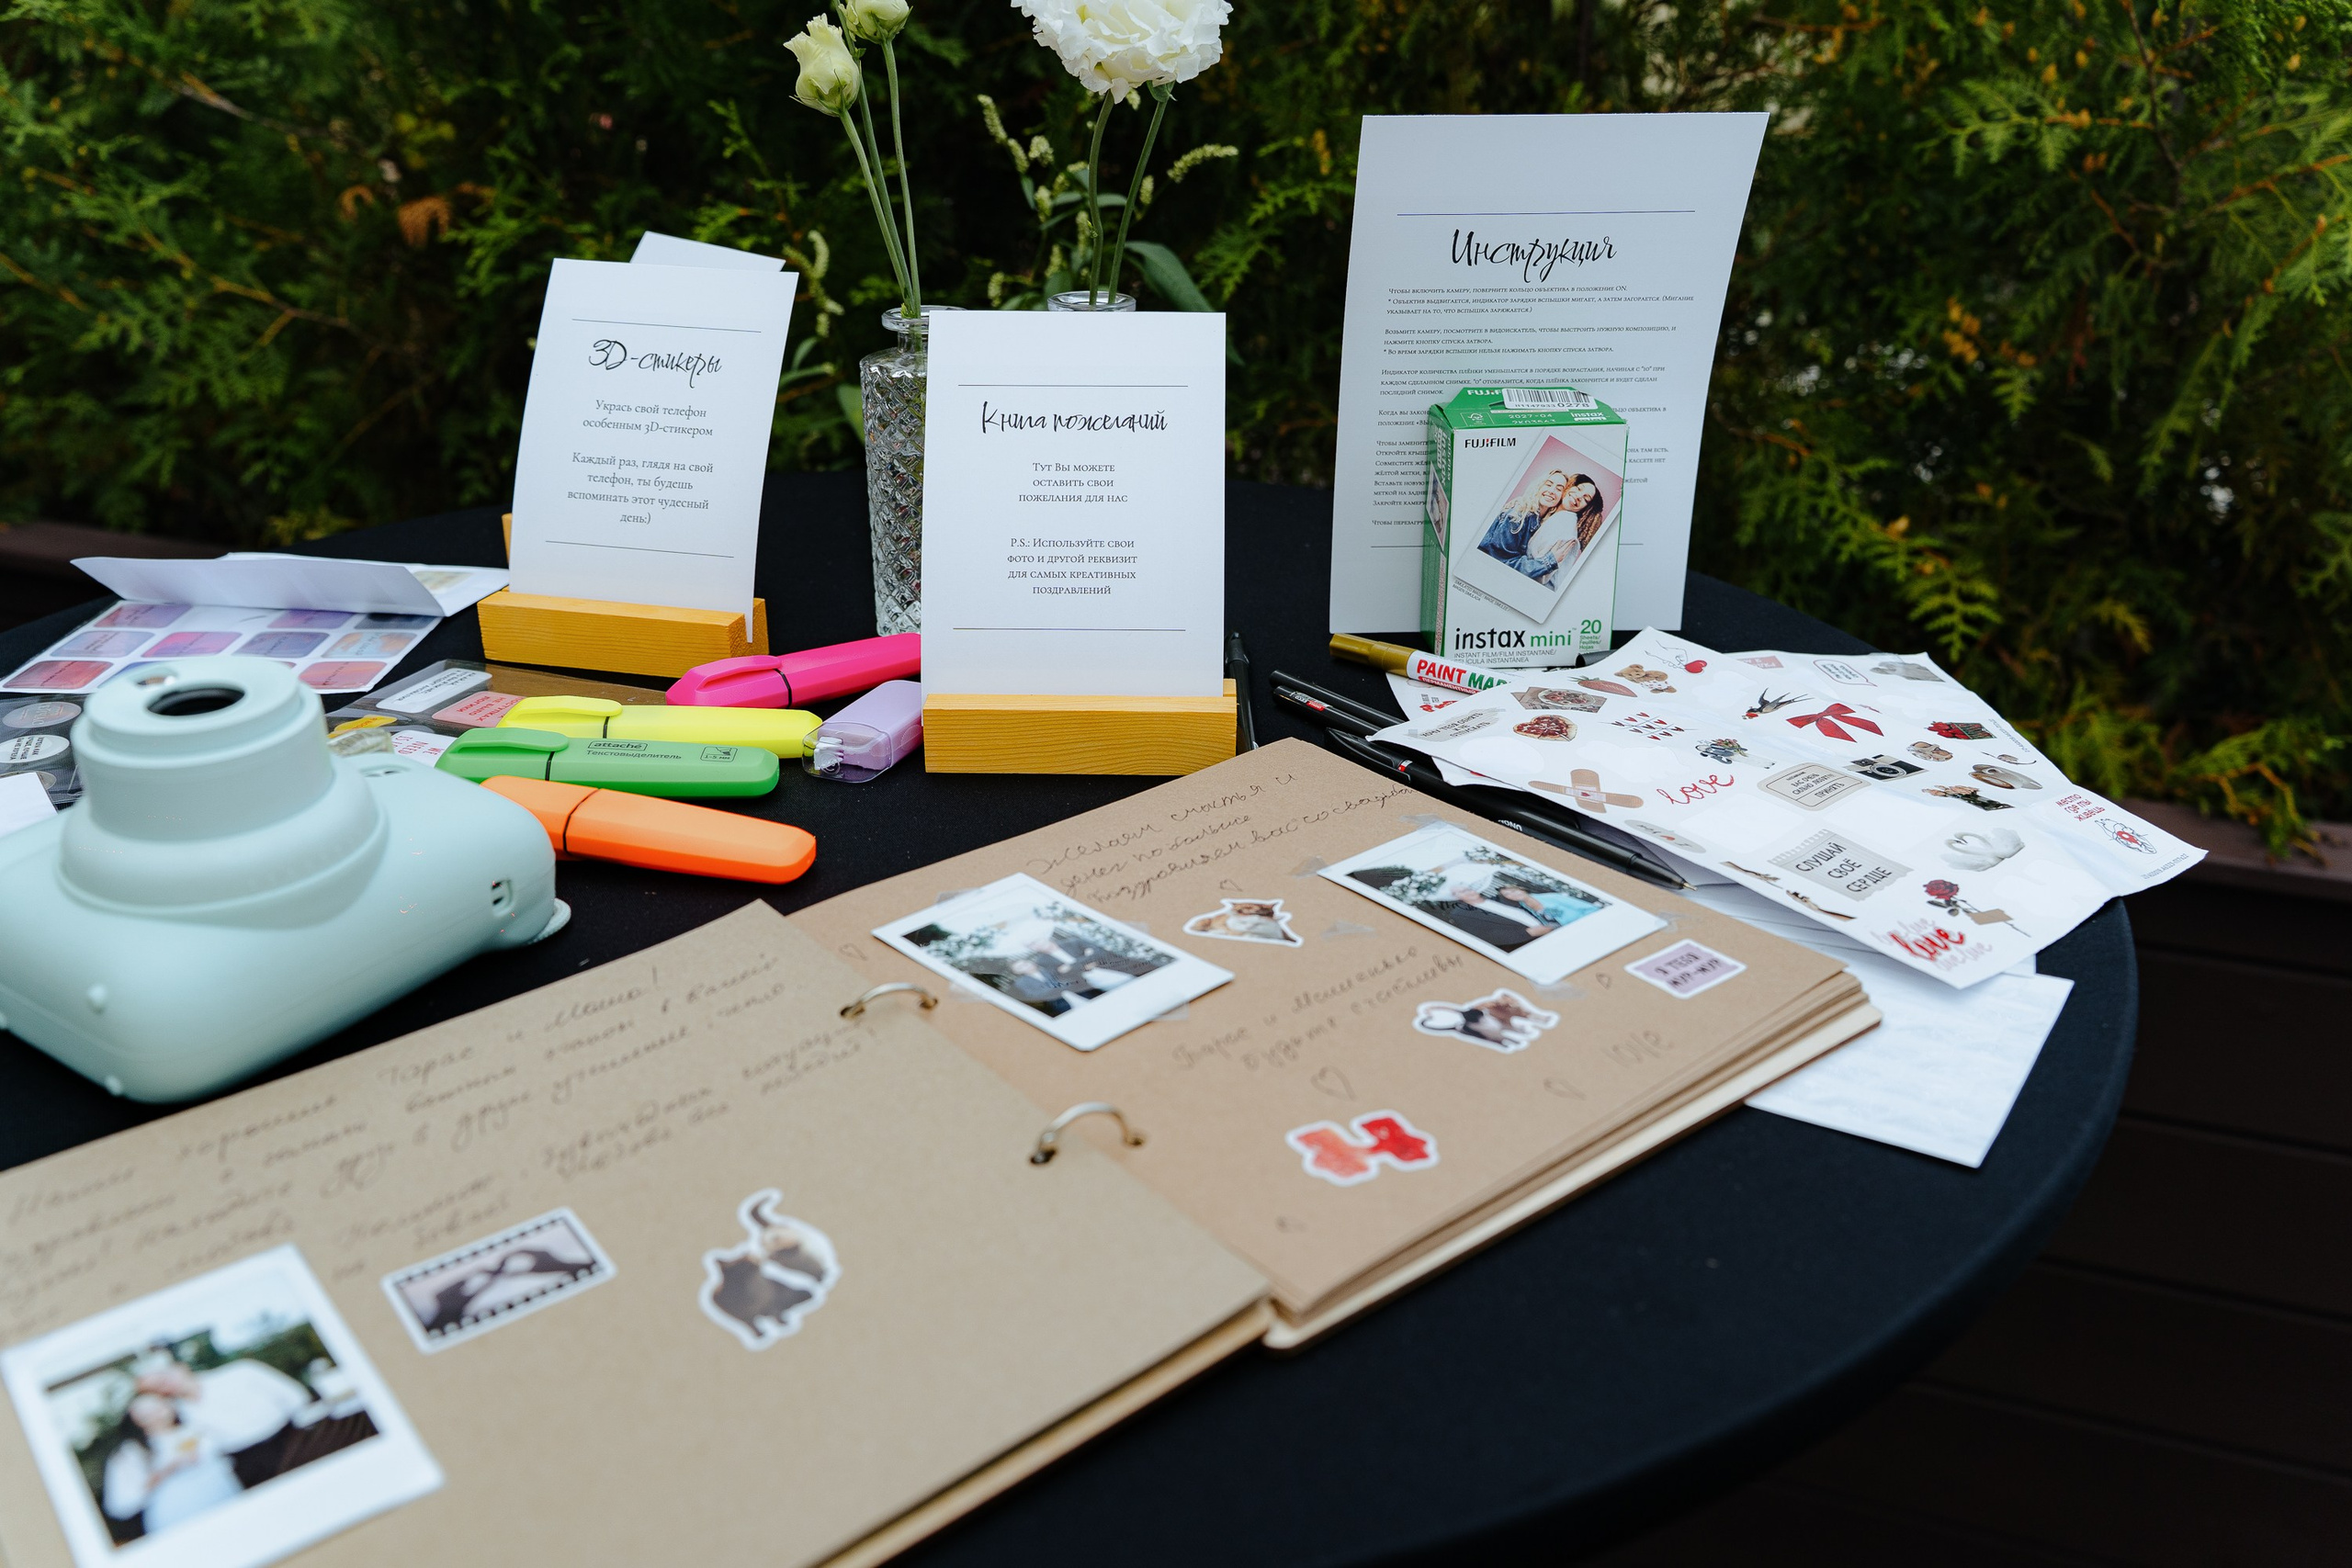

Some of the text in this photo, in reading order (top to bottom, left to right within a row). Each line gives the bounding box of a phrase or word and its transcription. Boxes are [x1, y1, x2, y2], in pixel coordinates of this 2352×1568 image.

[595, 399, 707, 421] Укрась свой телефон
[981, 400, 1169, 434] Книга пожеланий
[582, 416, 714, 439] особенным 3D-стикером
[1464, 436, 1517, 449] FUJIFILM
[571, 451, 714, 473] Каждый раз, глядя на свой
[586, 471, 694, 491] телефон, ты будешь
[567, 491, 709, 510] вспоминать этот чудесный
[1010, 537, 1031, 547] P.S.:
[1579, 618, 1602, 635] 20
[1454, 626, 1572, 650] instax mini
[1453, 651, 1480, 660] INSTANT
[1481, 650, 1515, 659] FILM/FILM
[1417, 659, 1467, 684] PAINT
[586, 750, 682, 760] Текстовыделитель
[594, 741, 642, 750] attaché
[1795, 841, 1848, 873] СЛУШАЙ
[1827, 857, 1862, 880] СВОЁ
[1846, 866, 1893, 894] СЕРДЦЕ
